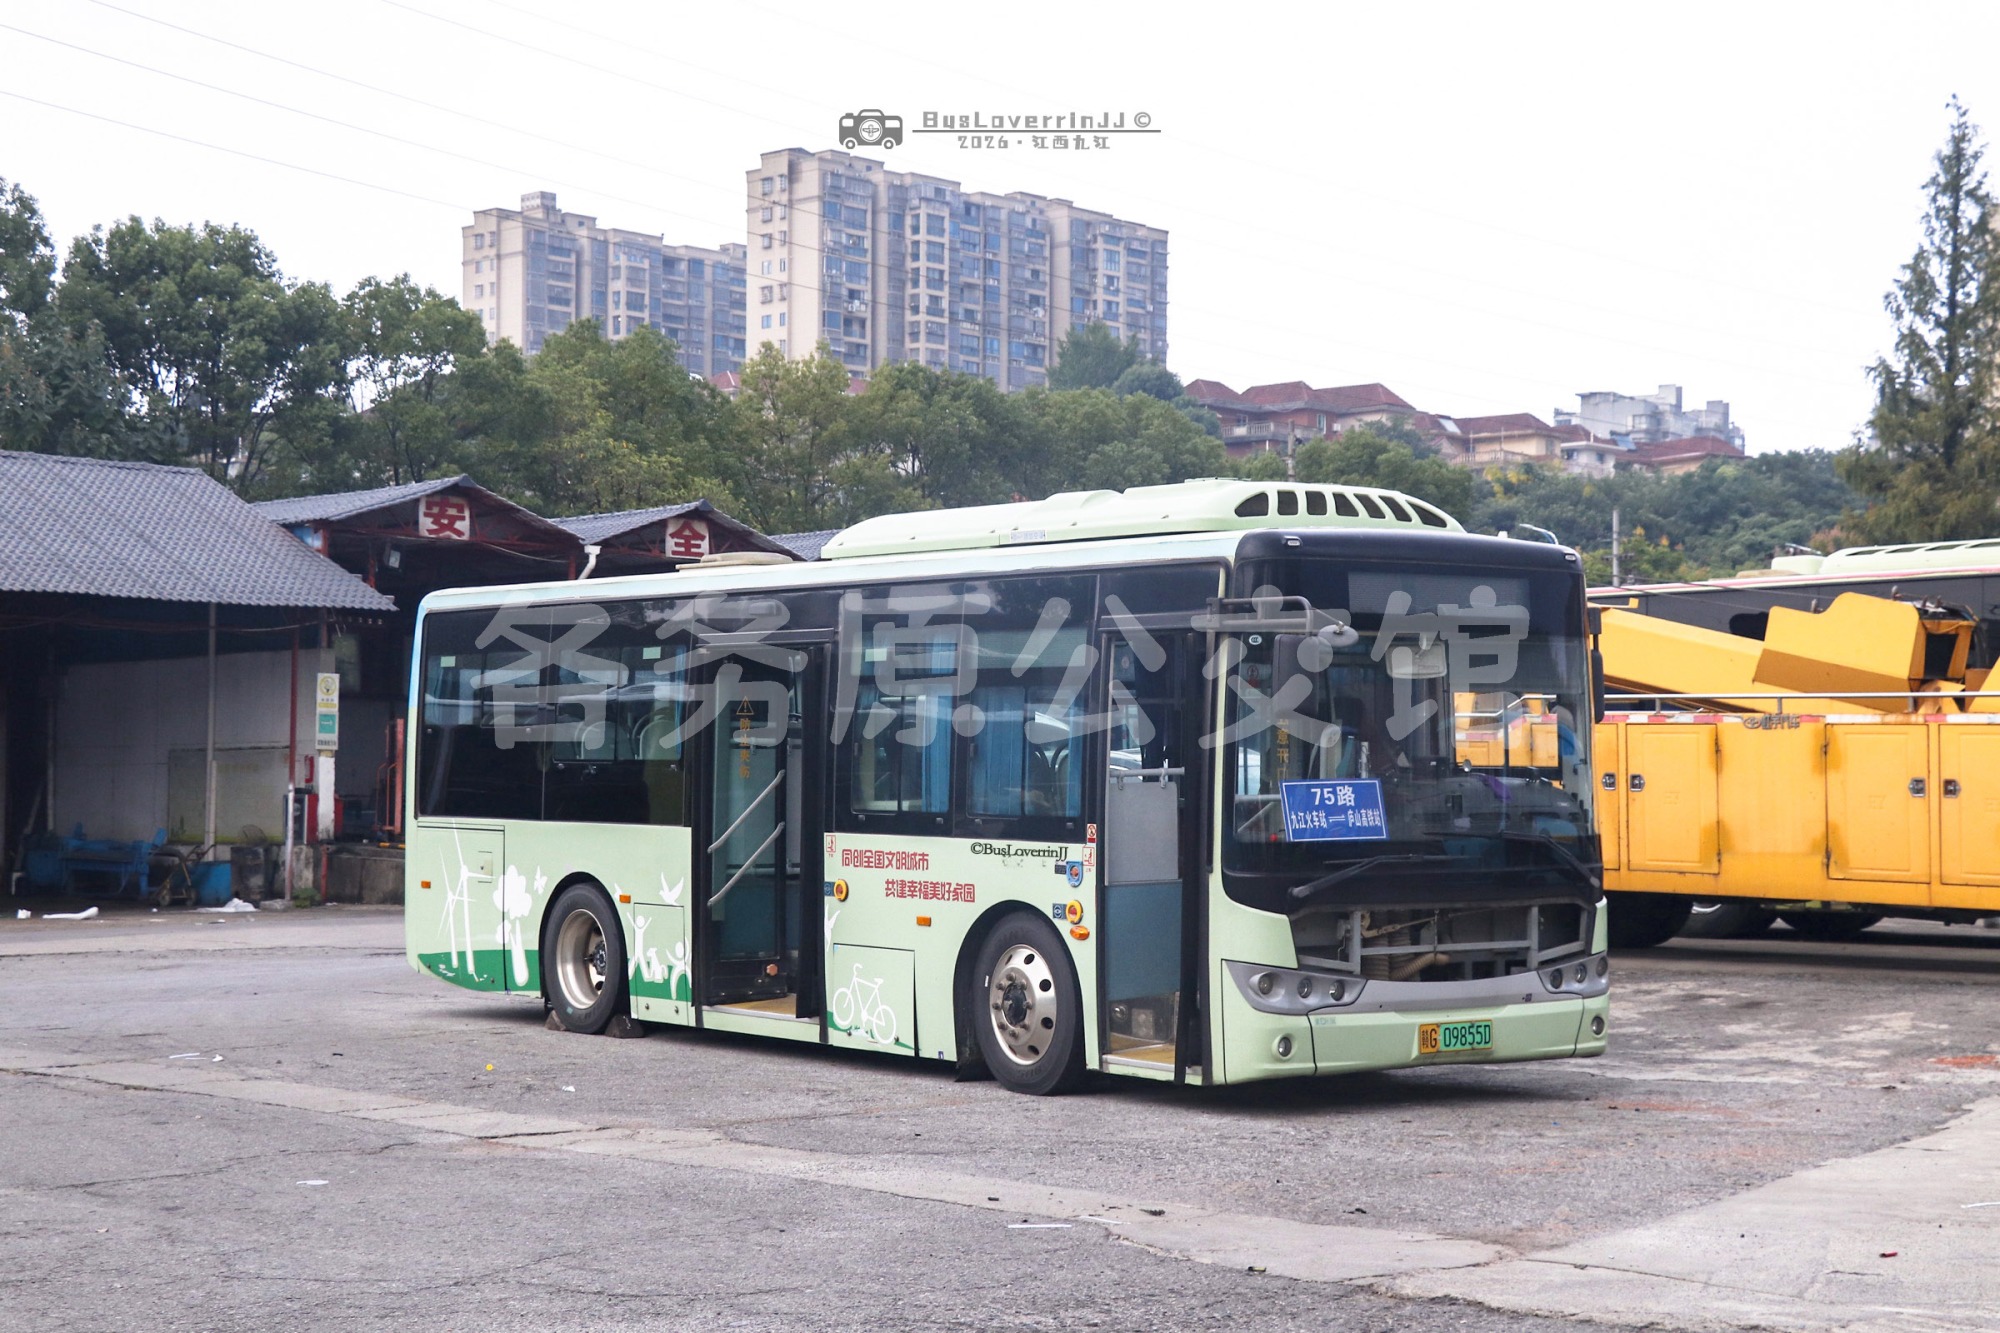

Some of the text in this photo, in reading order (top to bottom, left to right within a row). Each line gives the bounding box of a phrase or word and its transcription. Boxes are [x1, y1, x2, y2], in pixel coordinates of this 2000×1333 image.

[423, 499, 466, 538] 安
[669, 519, 706, 557] 全
[1310, 785, 1355, 806] 75路
[1291, 808, 1381, 829] 九江火车站 庐山高铁站
[841, 849, 930, 871] 同创全国文明城市
[884, 879, 976, 903] 共建幸福美好家园
[1443, 1024, 1491, 1048] 09855D
